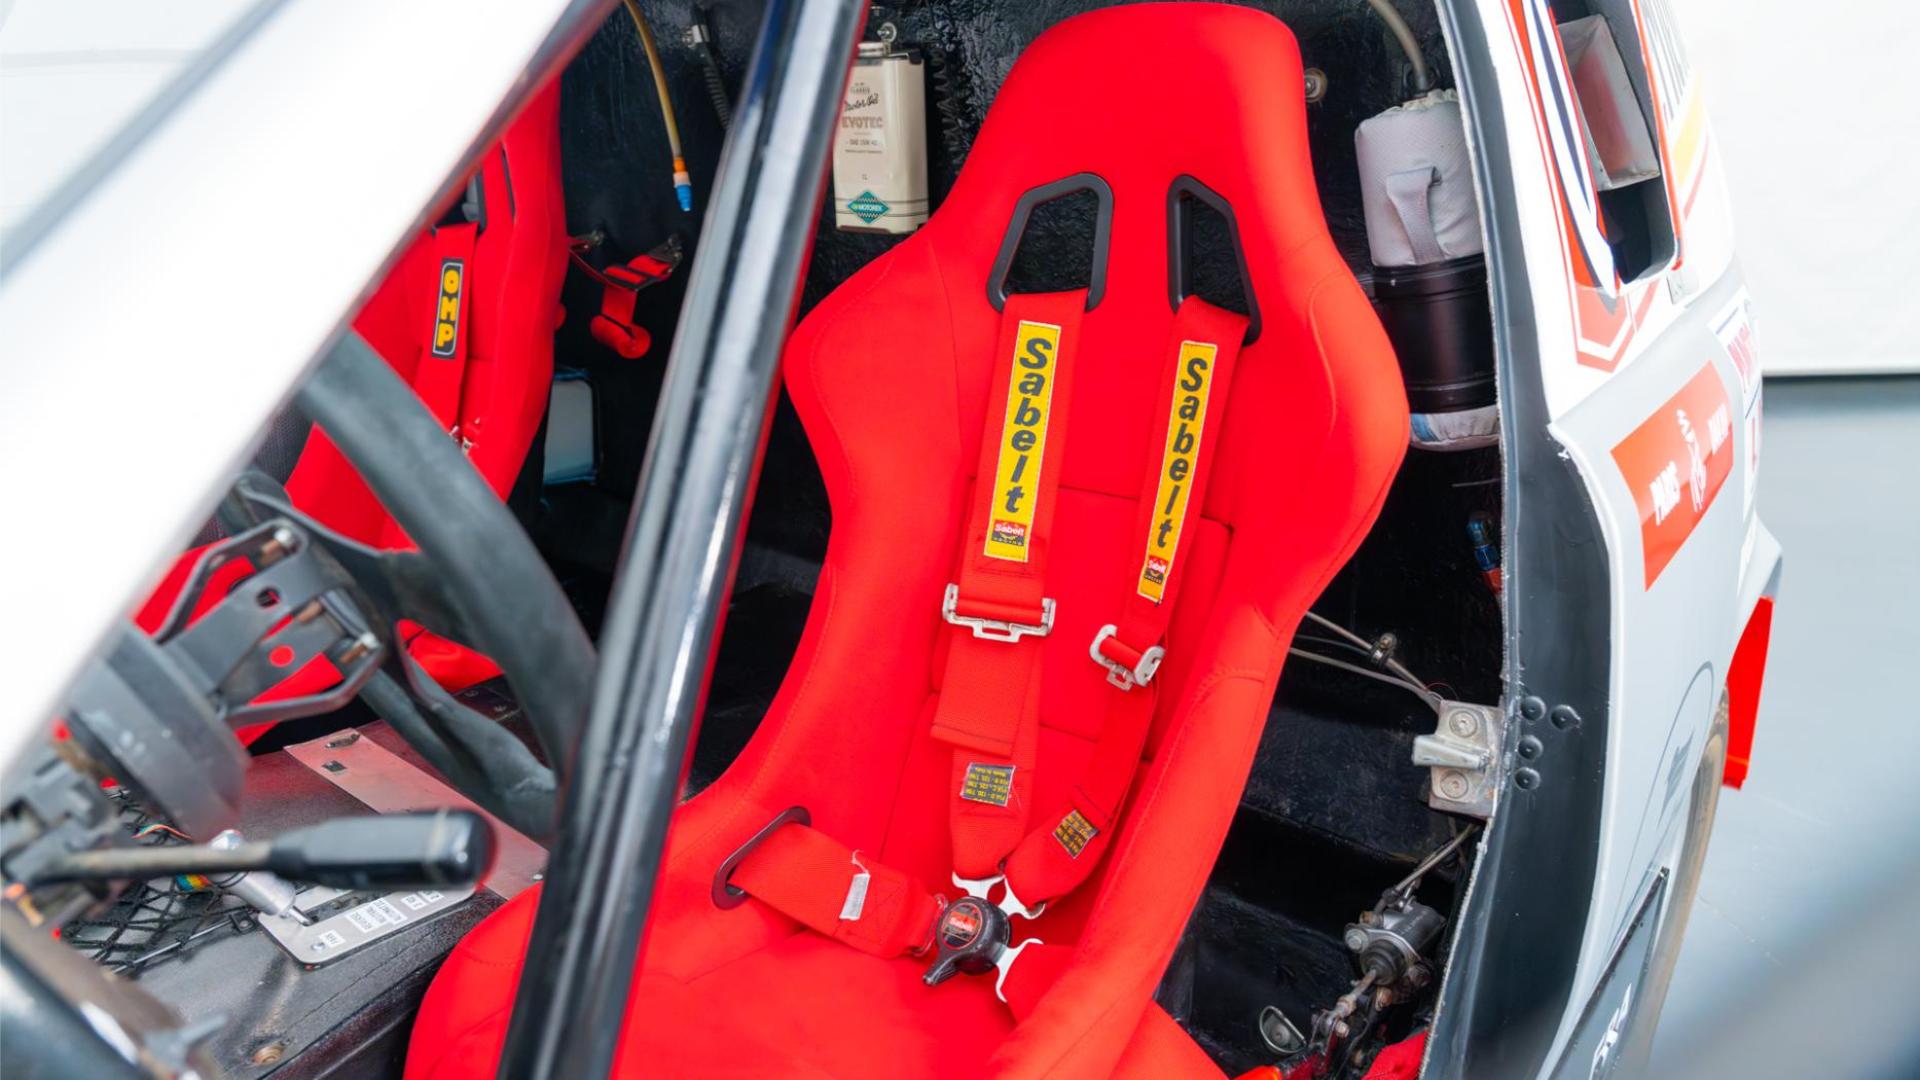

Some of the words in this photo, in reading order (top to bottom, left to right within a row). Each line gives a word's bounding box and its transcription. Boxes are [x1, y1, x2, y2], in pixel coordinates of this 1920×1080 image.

[841, 116, 883, 129] EVOTEC
[437, 269, 460, 347] OMP
[1004, 337, 1053, 514] Sabelt
[1156, 357, 1209, 549] Sabelt
[994, 521, 1025, 537] Sabelt
